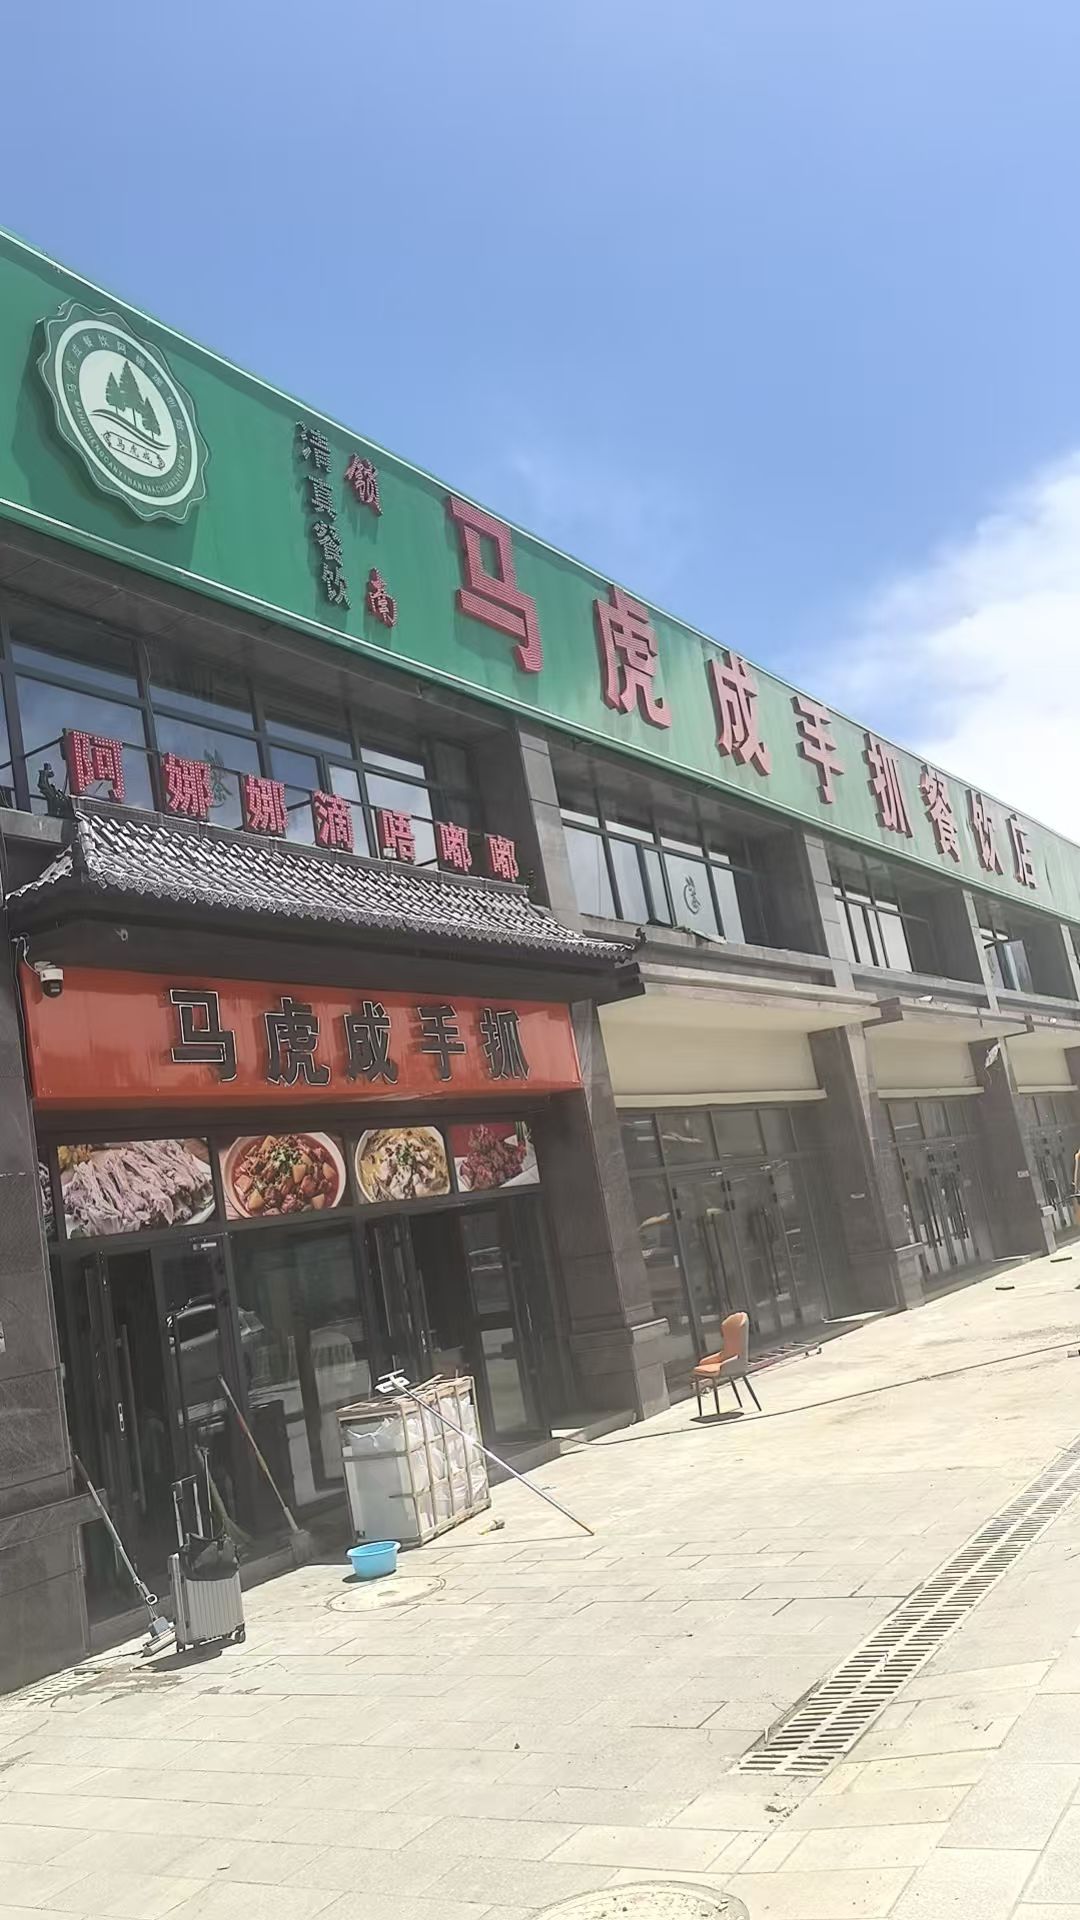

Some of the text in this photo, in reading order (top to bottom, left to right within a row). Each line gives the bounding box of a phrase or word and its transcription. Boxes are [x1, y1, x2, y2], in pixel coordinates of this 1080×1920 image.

[296, 420, 351, 609] 清真餐饮
[449, 495, 1038, 889] 马虎成手抓餐饮店
[170, 988, 531, 1087] 马虎成手抓
